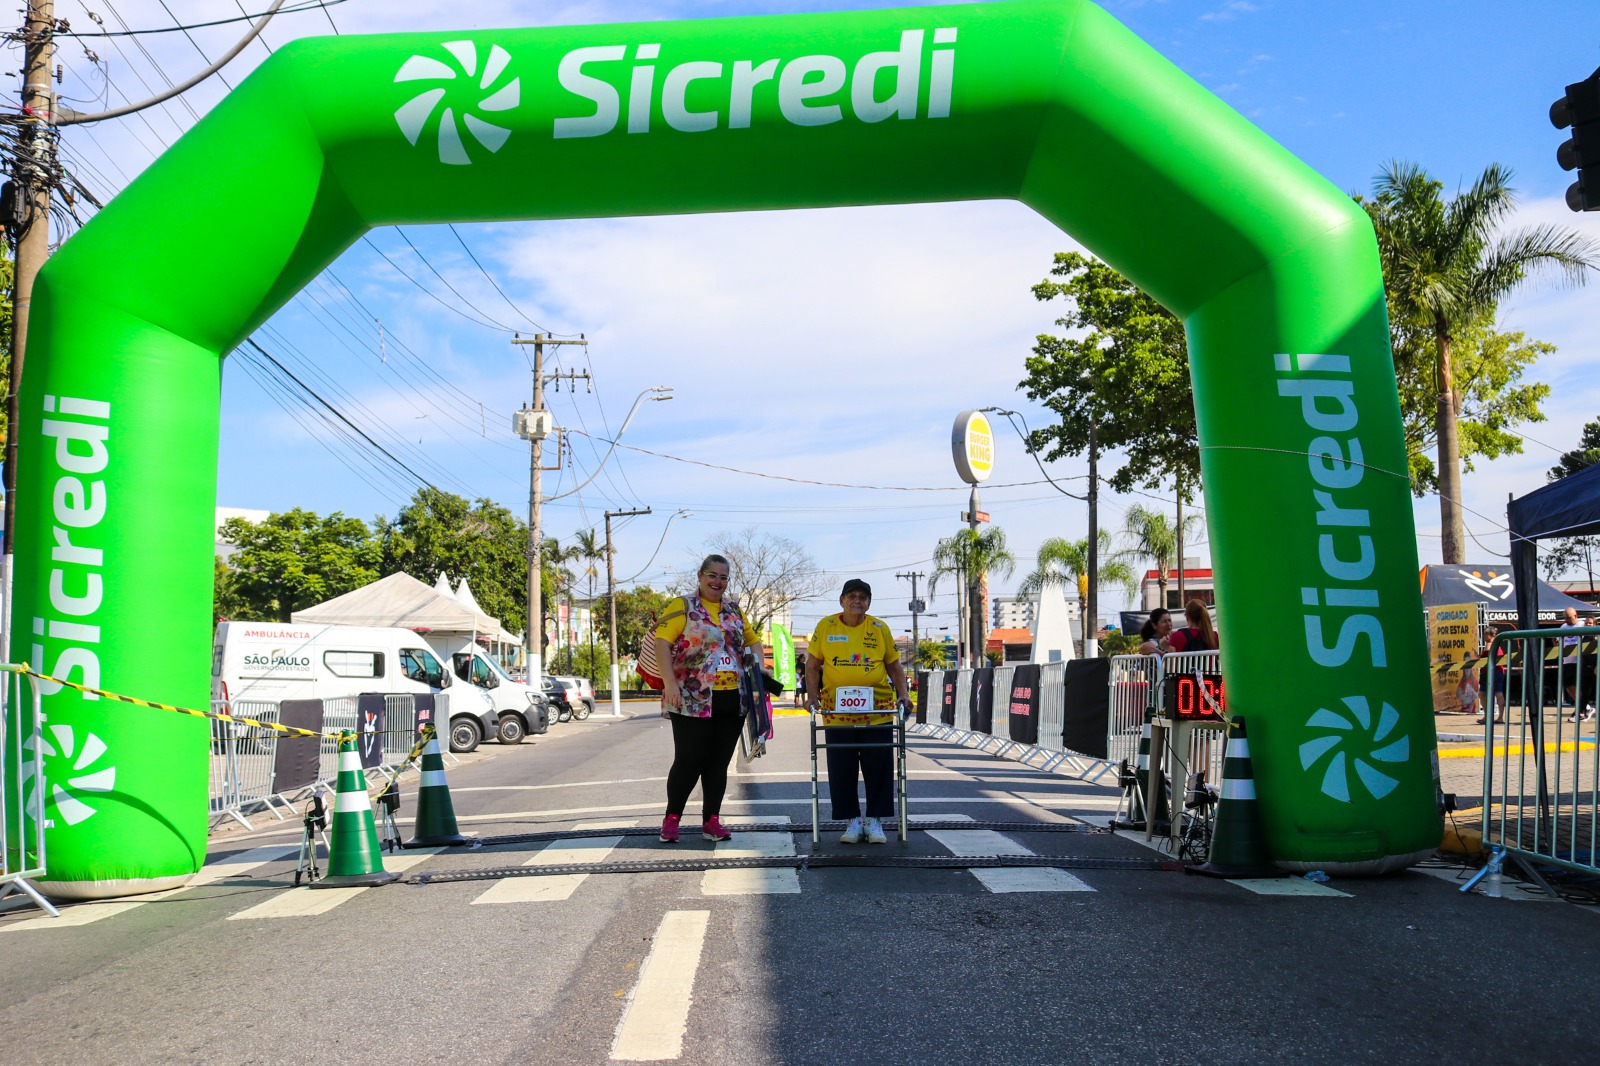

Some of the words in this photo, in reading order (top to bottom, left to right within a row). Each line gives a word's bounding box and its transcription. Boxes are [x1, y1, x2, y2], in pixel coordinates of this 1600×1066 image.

[553, 27, 958, 139] Sicredi
[970, 432, 990, 446] BURGER
[970, 444, 990, 462] KING
[1273, 353, 1387, 667] Sicredi
[32, 394, 110, 701] Sicredi
[1436, 610, 1468, 620] OBRIGADO
[244, 630, 310, 639] AMBULÂNCIA
[1437, 626, 1449, 635] POR
[1450, 625, 1468, 634] ESTAR
[1438, 640, 1452, 649] AQUI
[1453, 640, 1465, 648] POR
[244, 653, 269, 665] SÃO
[271, 656, 310, 666] PAULO
[719, 657, 731, 665] 10
[840, 698, 866, 707] 3007
[1178, 679, 1225, 714] 00:
